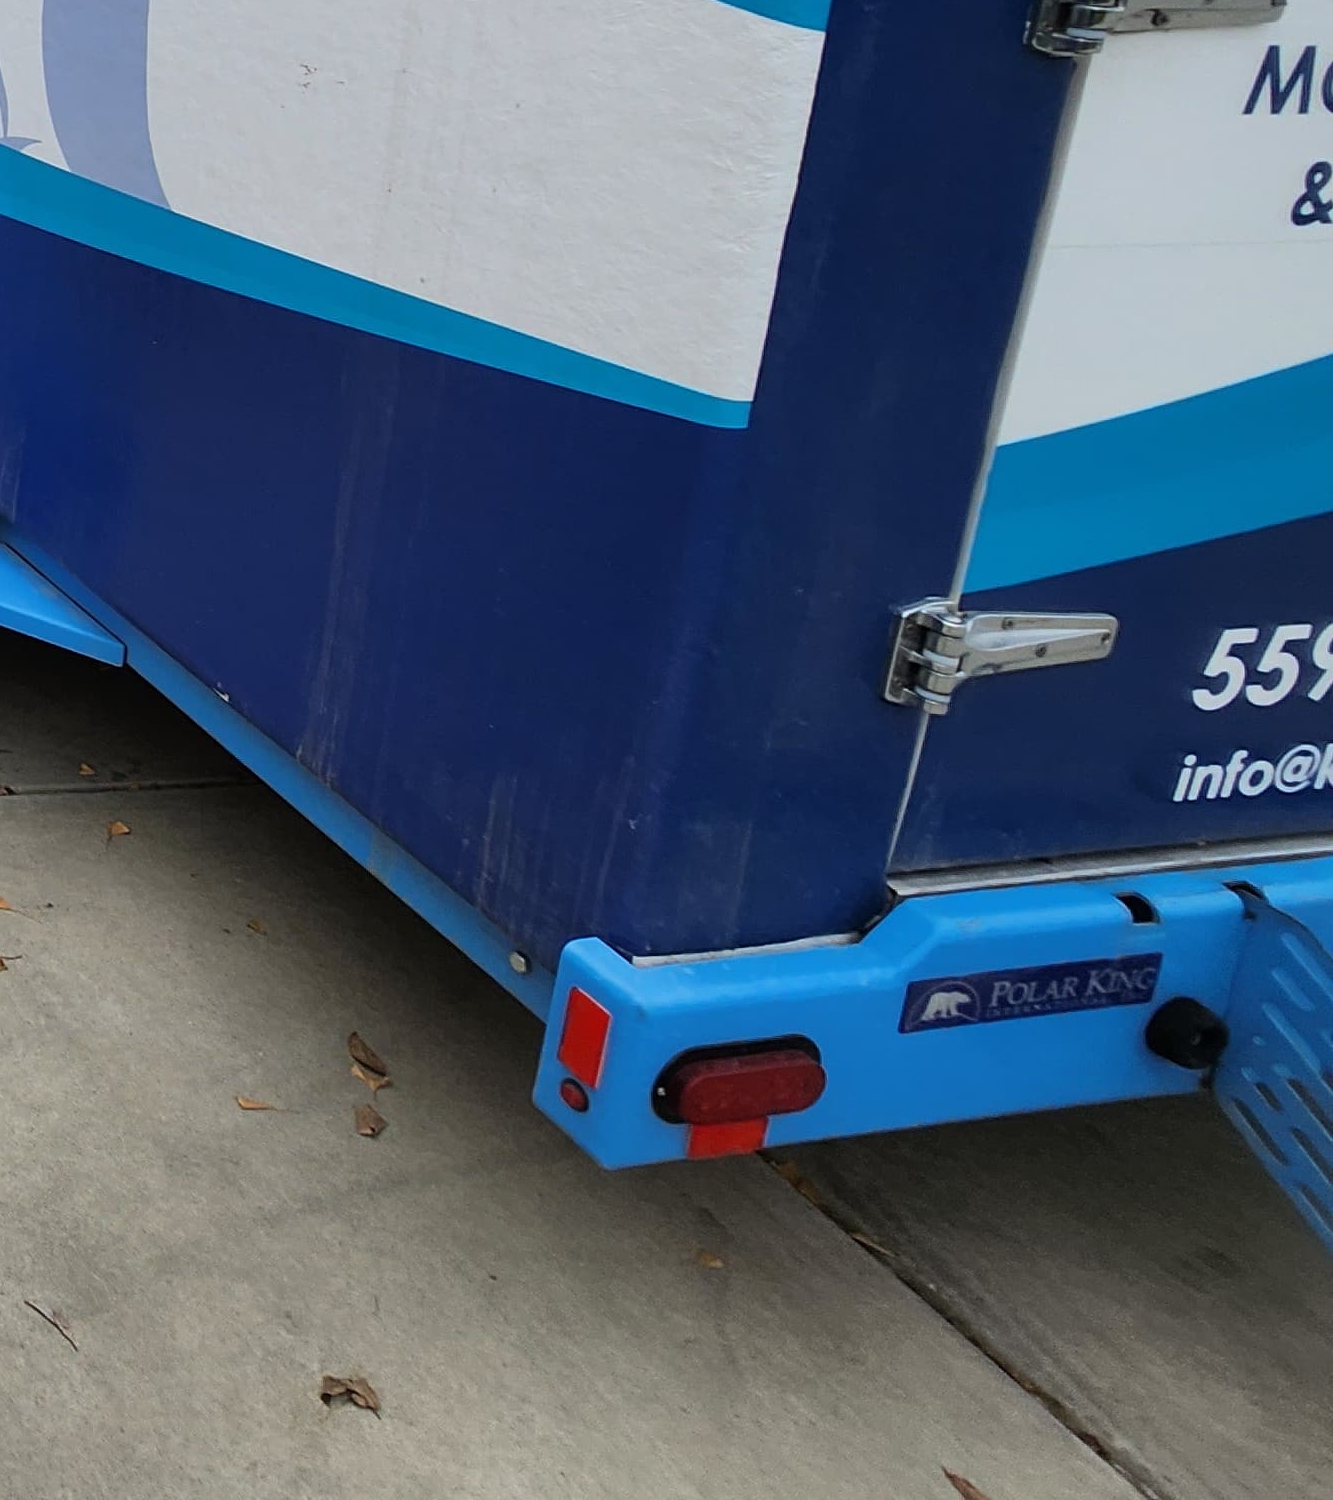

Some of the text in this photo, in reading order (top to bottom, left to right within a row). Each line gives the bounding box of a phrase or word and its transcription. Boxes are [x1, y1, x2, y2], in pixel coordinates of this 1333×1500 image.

[1242, 44, 1333, 115] M
[988, 976, 1080, 1008] POLAR
[1085, 967, 1158, 998] KING
